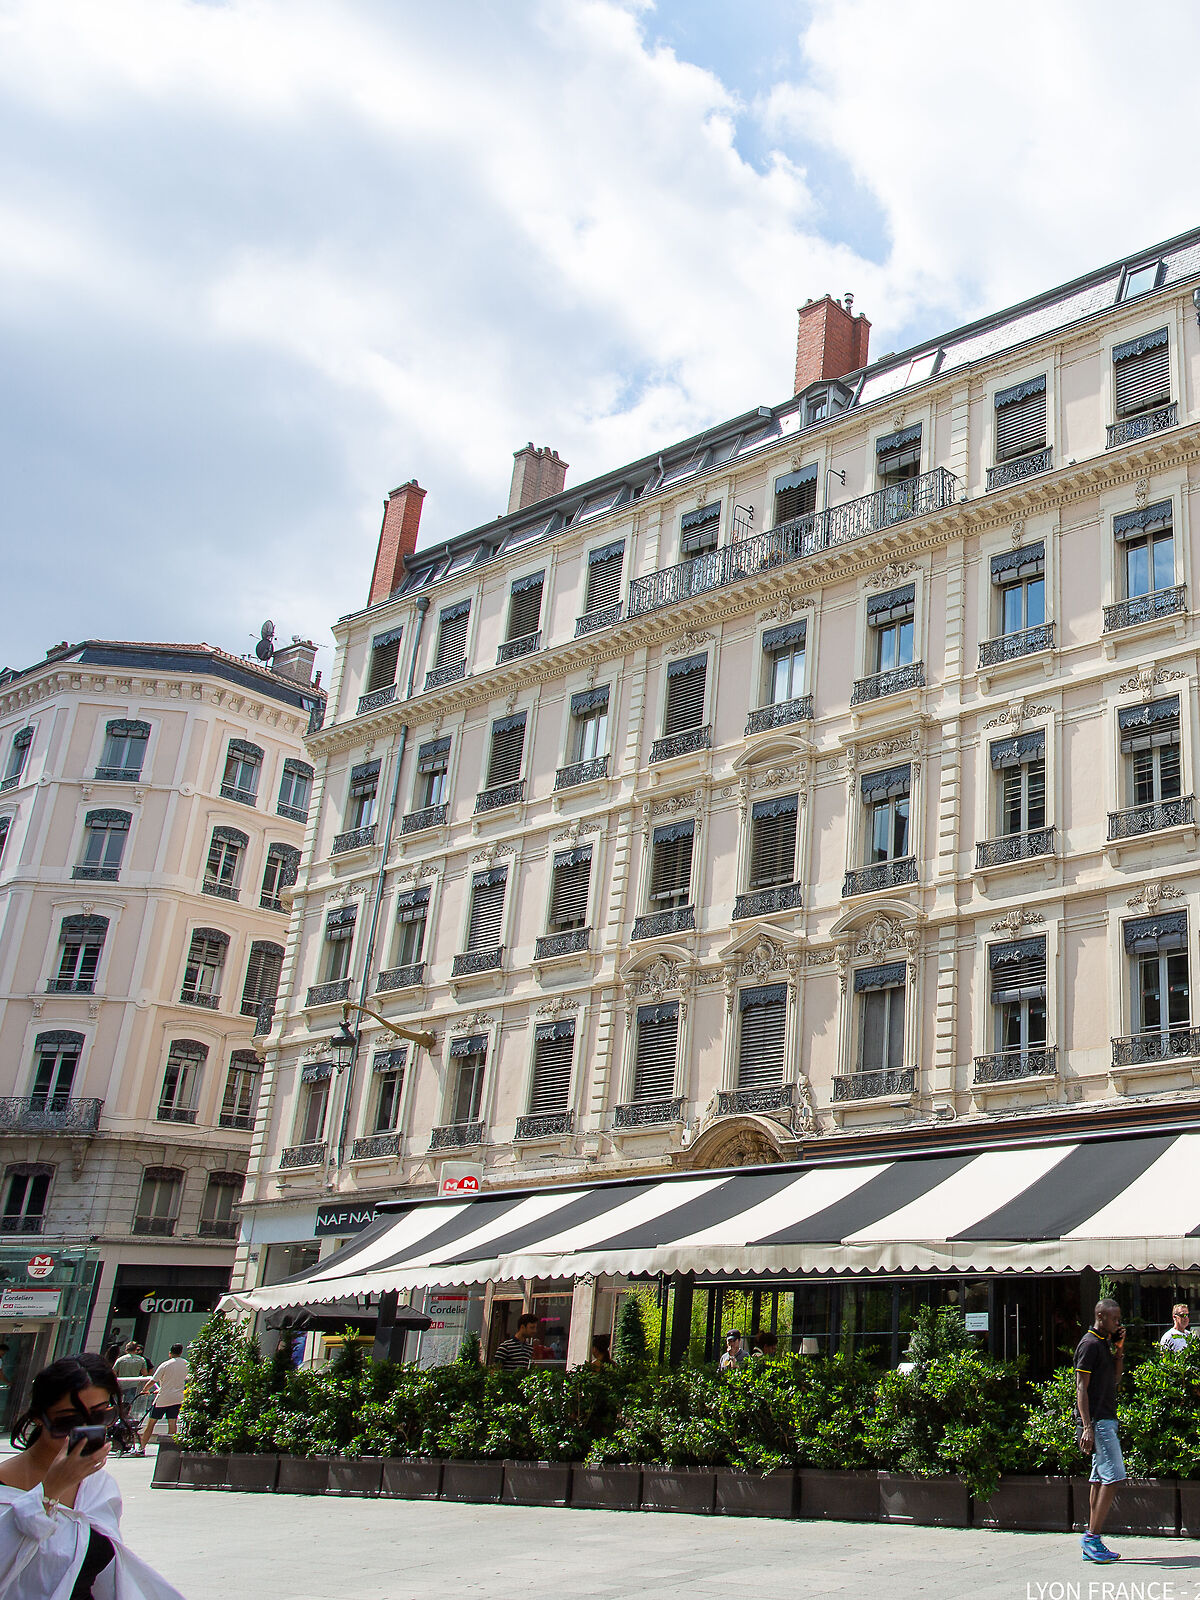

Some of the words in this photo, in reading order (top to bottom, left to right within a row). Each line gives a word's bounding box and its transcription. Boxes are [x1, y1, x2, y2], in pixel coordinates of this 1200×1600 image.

[445, 1182, 458, 1190] M
[463, 1180, 476, 1188] M
[316, 1213, 348, 1227] NAF
[34, 1256, 52, 1266] M
[139, 1290, 194, 1313] éram
